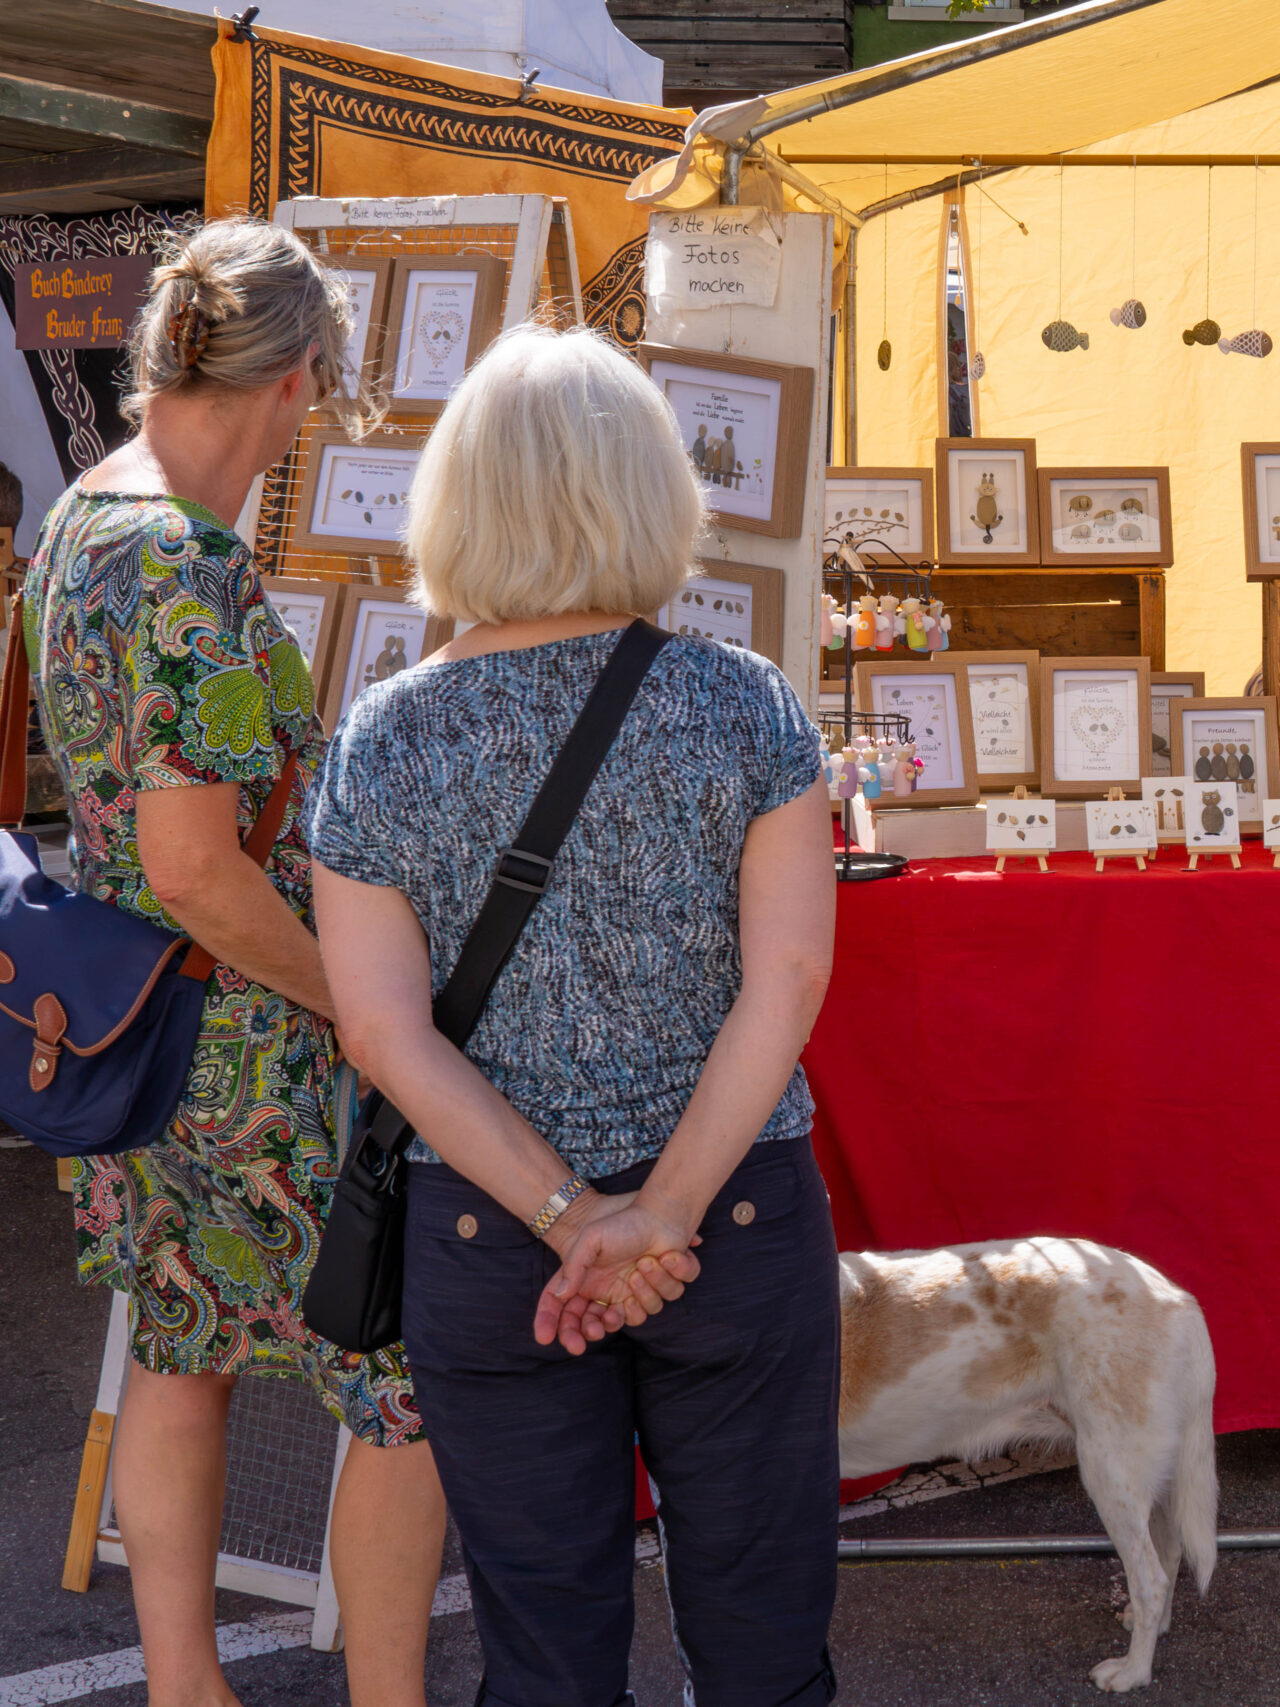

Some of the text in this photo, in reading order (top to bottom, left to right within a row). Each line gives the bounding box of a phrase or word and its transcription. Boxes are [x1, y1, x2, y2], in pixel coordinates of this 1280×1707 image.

[669, 215, 705, 234] Bitte
[682, 244, 740, 264] Fotos
[31, 267, 112, 299] Buch Binderey
[46, 306, 122, 343] Bruder Franz
